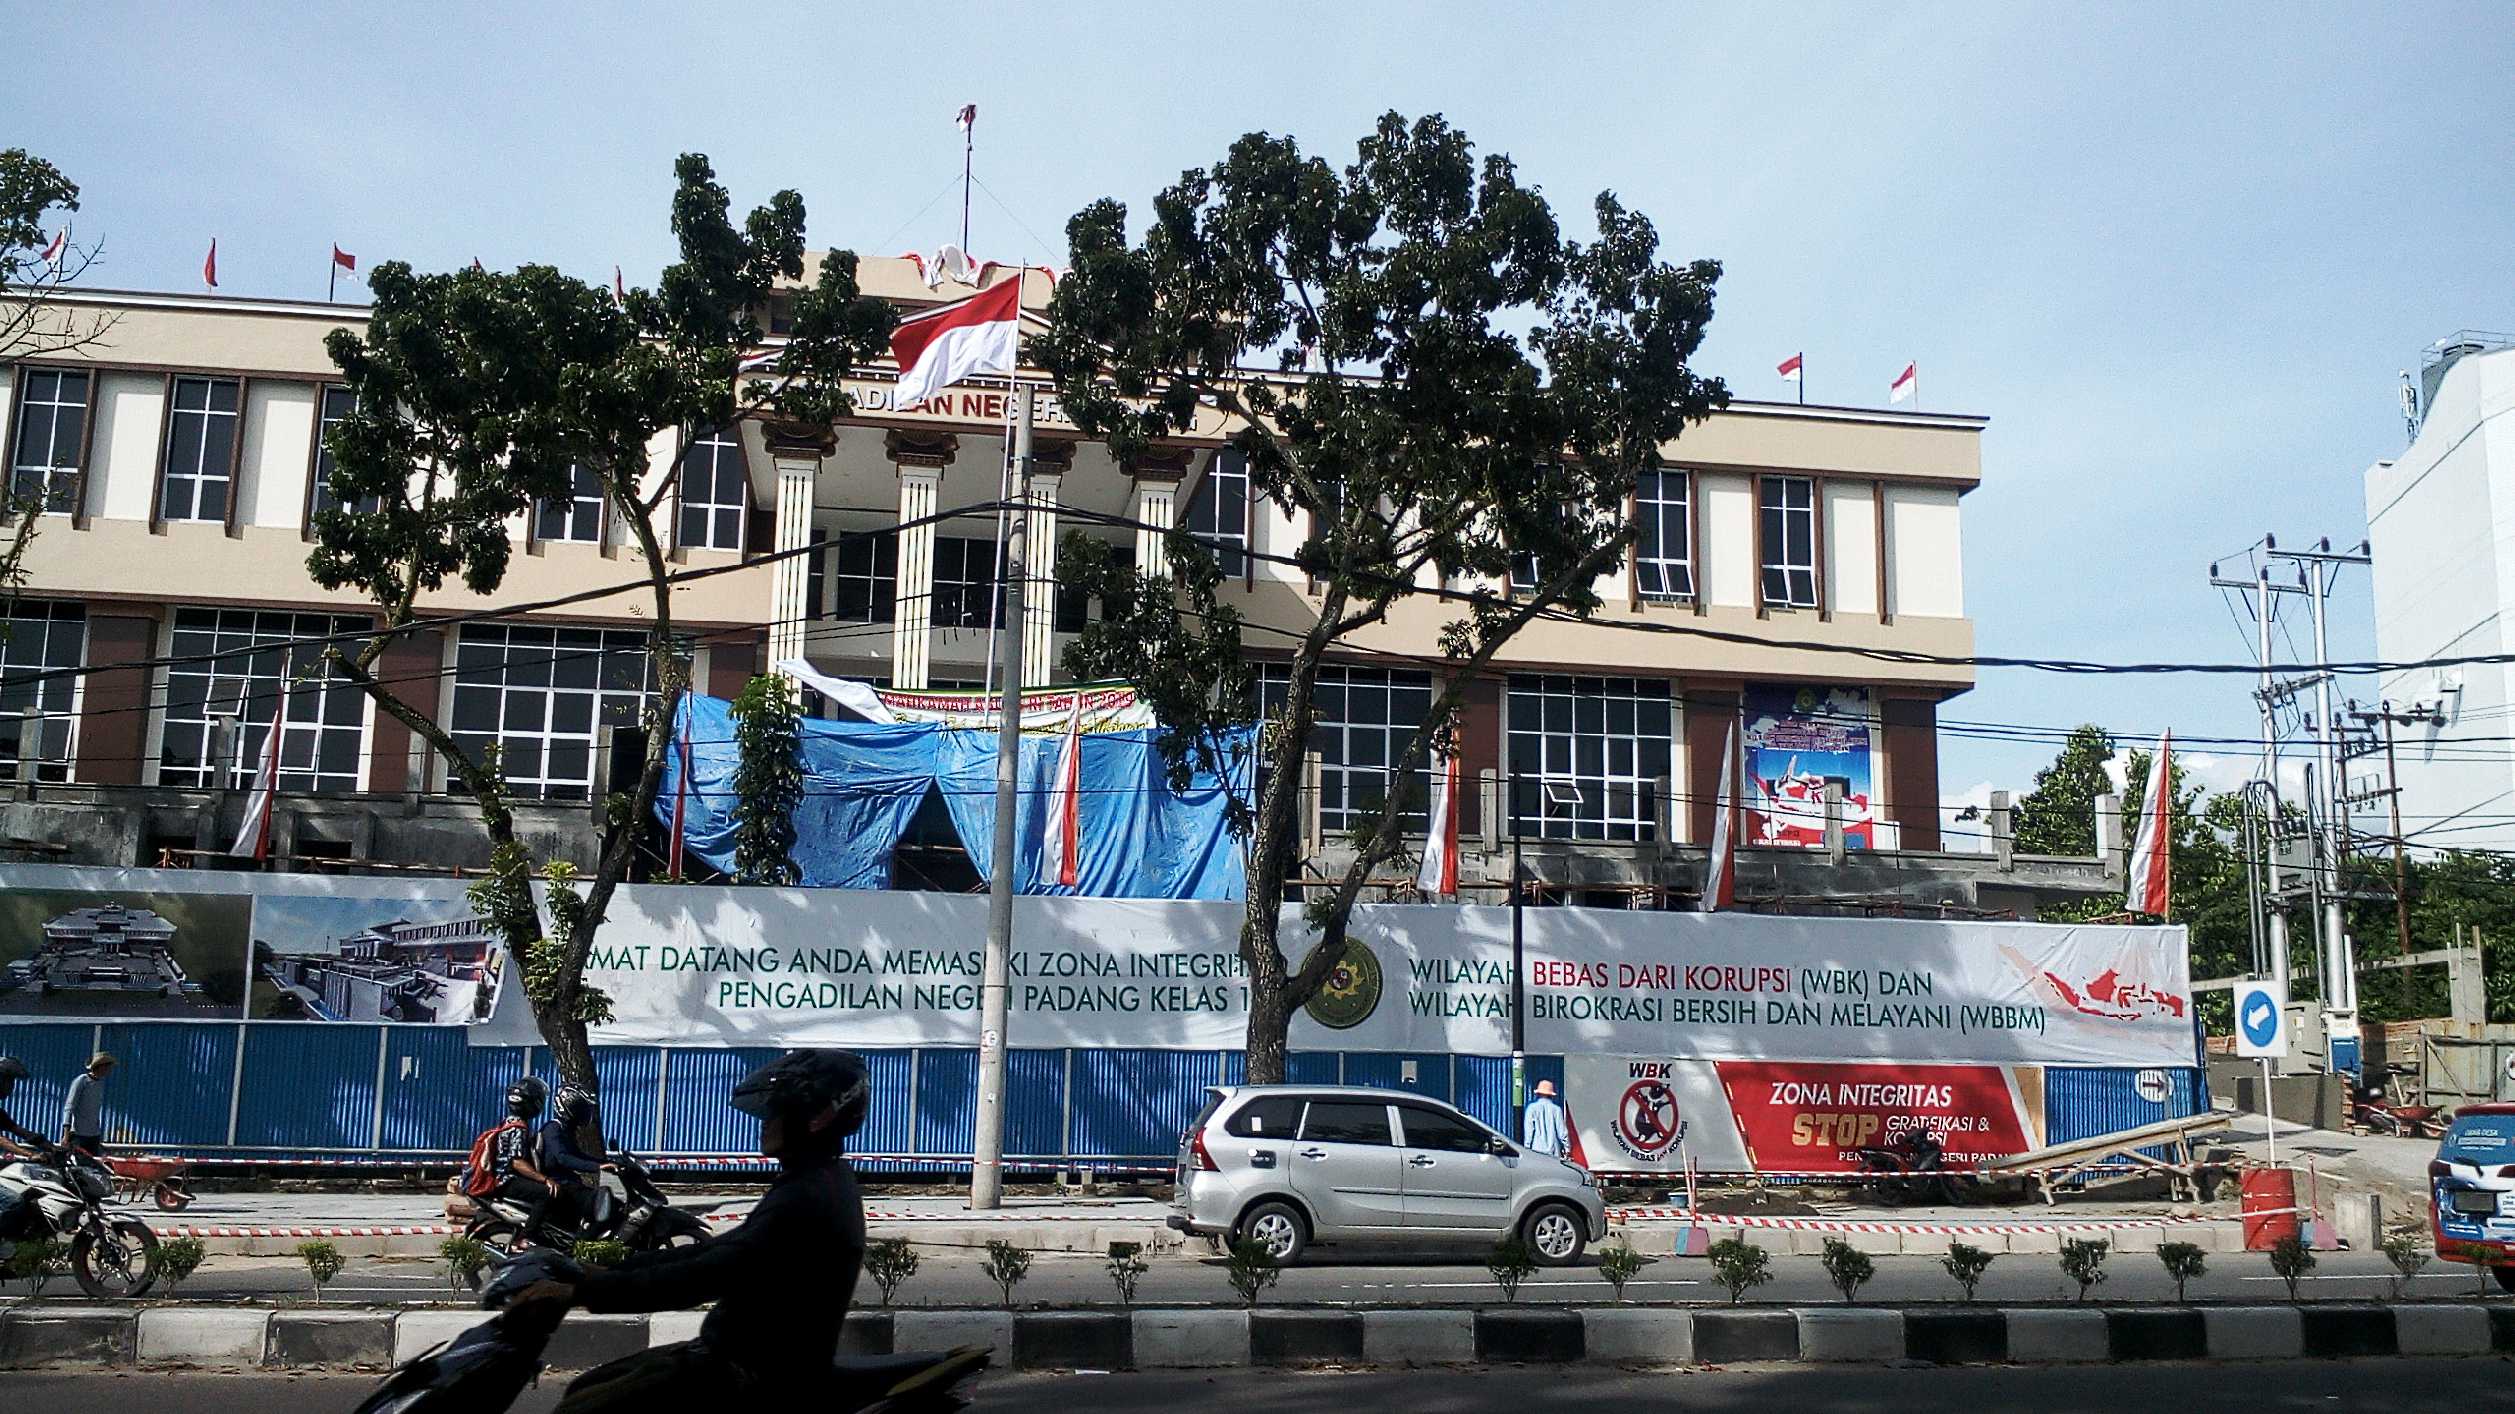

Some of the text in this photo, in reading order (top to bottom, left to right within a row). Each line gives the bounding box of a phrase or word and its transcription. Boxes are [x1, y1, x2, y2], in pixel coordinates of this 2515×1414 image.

[962, 392, 1071, 424] NEGER
[660, 946, 780, 972] DATANG
[788, 948, 874, 975] ANDA
[882, 950, 1028, 977] MEMASKI
[1039, 952, 1121, 978] ZONA
[1131, 953, 1251, 978] INTEGRIT
[719, 982, 902, 1009] PENGADILAN
[914, 984, 1012, 1010] NEGEI
[1024, 985, 1140, 1012] PADANG
[1151, 987, 1228, 1012] KELAS
[1534, 961, 1609, 988] BEBAS
[1618, 963, 1676, 990] DARI
[1685, 965, 1791, 993] KORUPSI
[1801, 968, 1869, 1002] (WBK)
[1879, 971, 1932, 997] DAN
[1533, 995, 1663, 1022] BIROKRASI
[1674, 1000, 1756, 1025] BERSIH
[1766, 1002, 1822, 1026] DAN
[1830, 1004, 1951, 1029] MELAYANI
[1959, 1005, 2046, 1035] (WBBM)
[1629, 1062, 1673, 1079] WBK
[1769, 1082, 1953, 1108] ZONA INTEGRITAS
[1791, 1113, 1880, 1147] STOP
[1977, 1117, 1990, 1131] &
